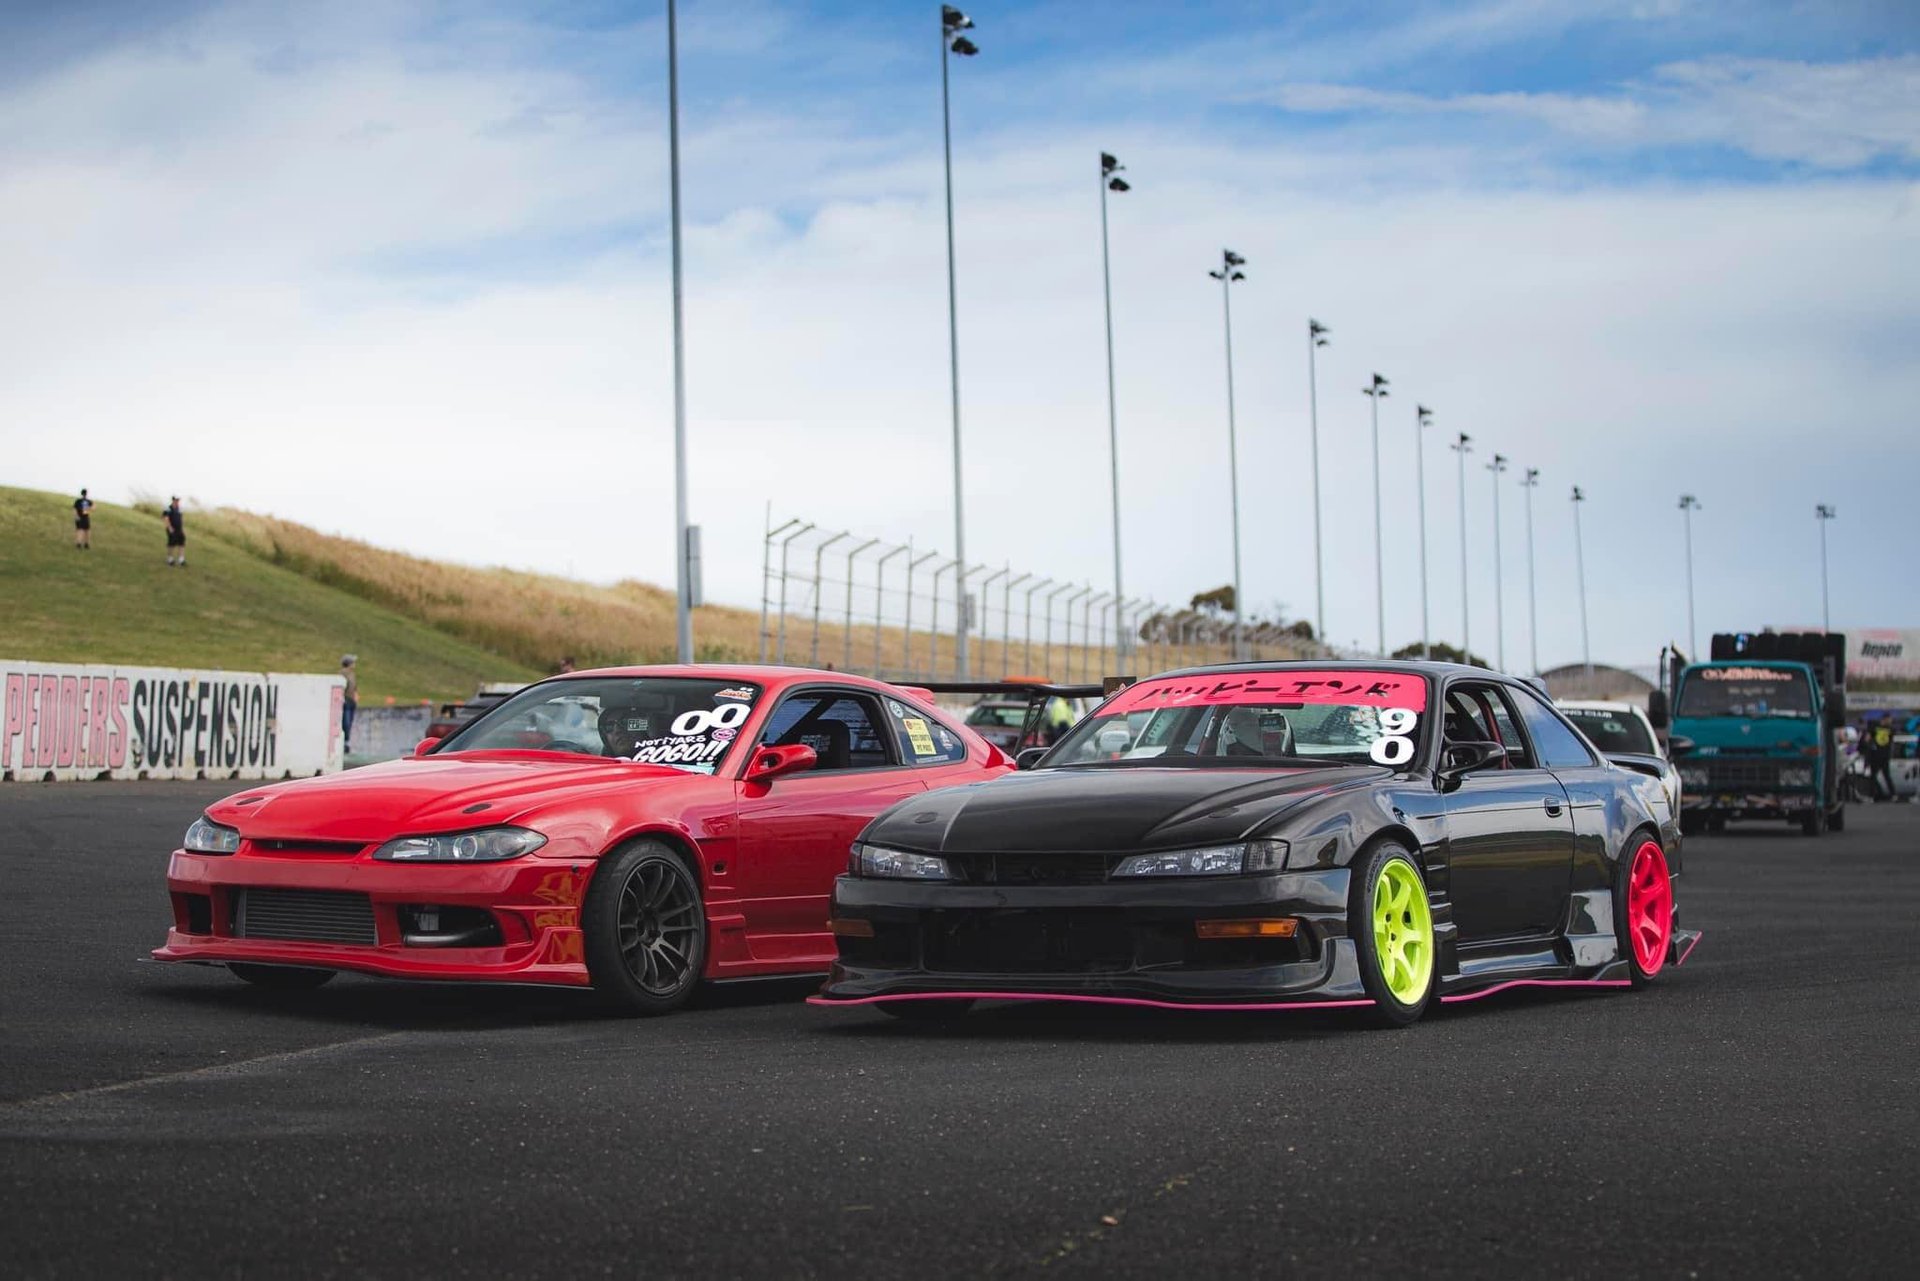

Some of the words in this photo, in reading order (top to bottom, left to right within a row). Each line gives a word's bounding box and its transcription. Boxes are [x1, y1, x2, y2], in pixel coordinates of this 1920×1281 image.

[2, 673, 129, 768] PEDDERS
[131, 679, 278, 769] SUSPENSION
[632, 740, 730, 763] GOGO!!
